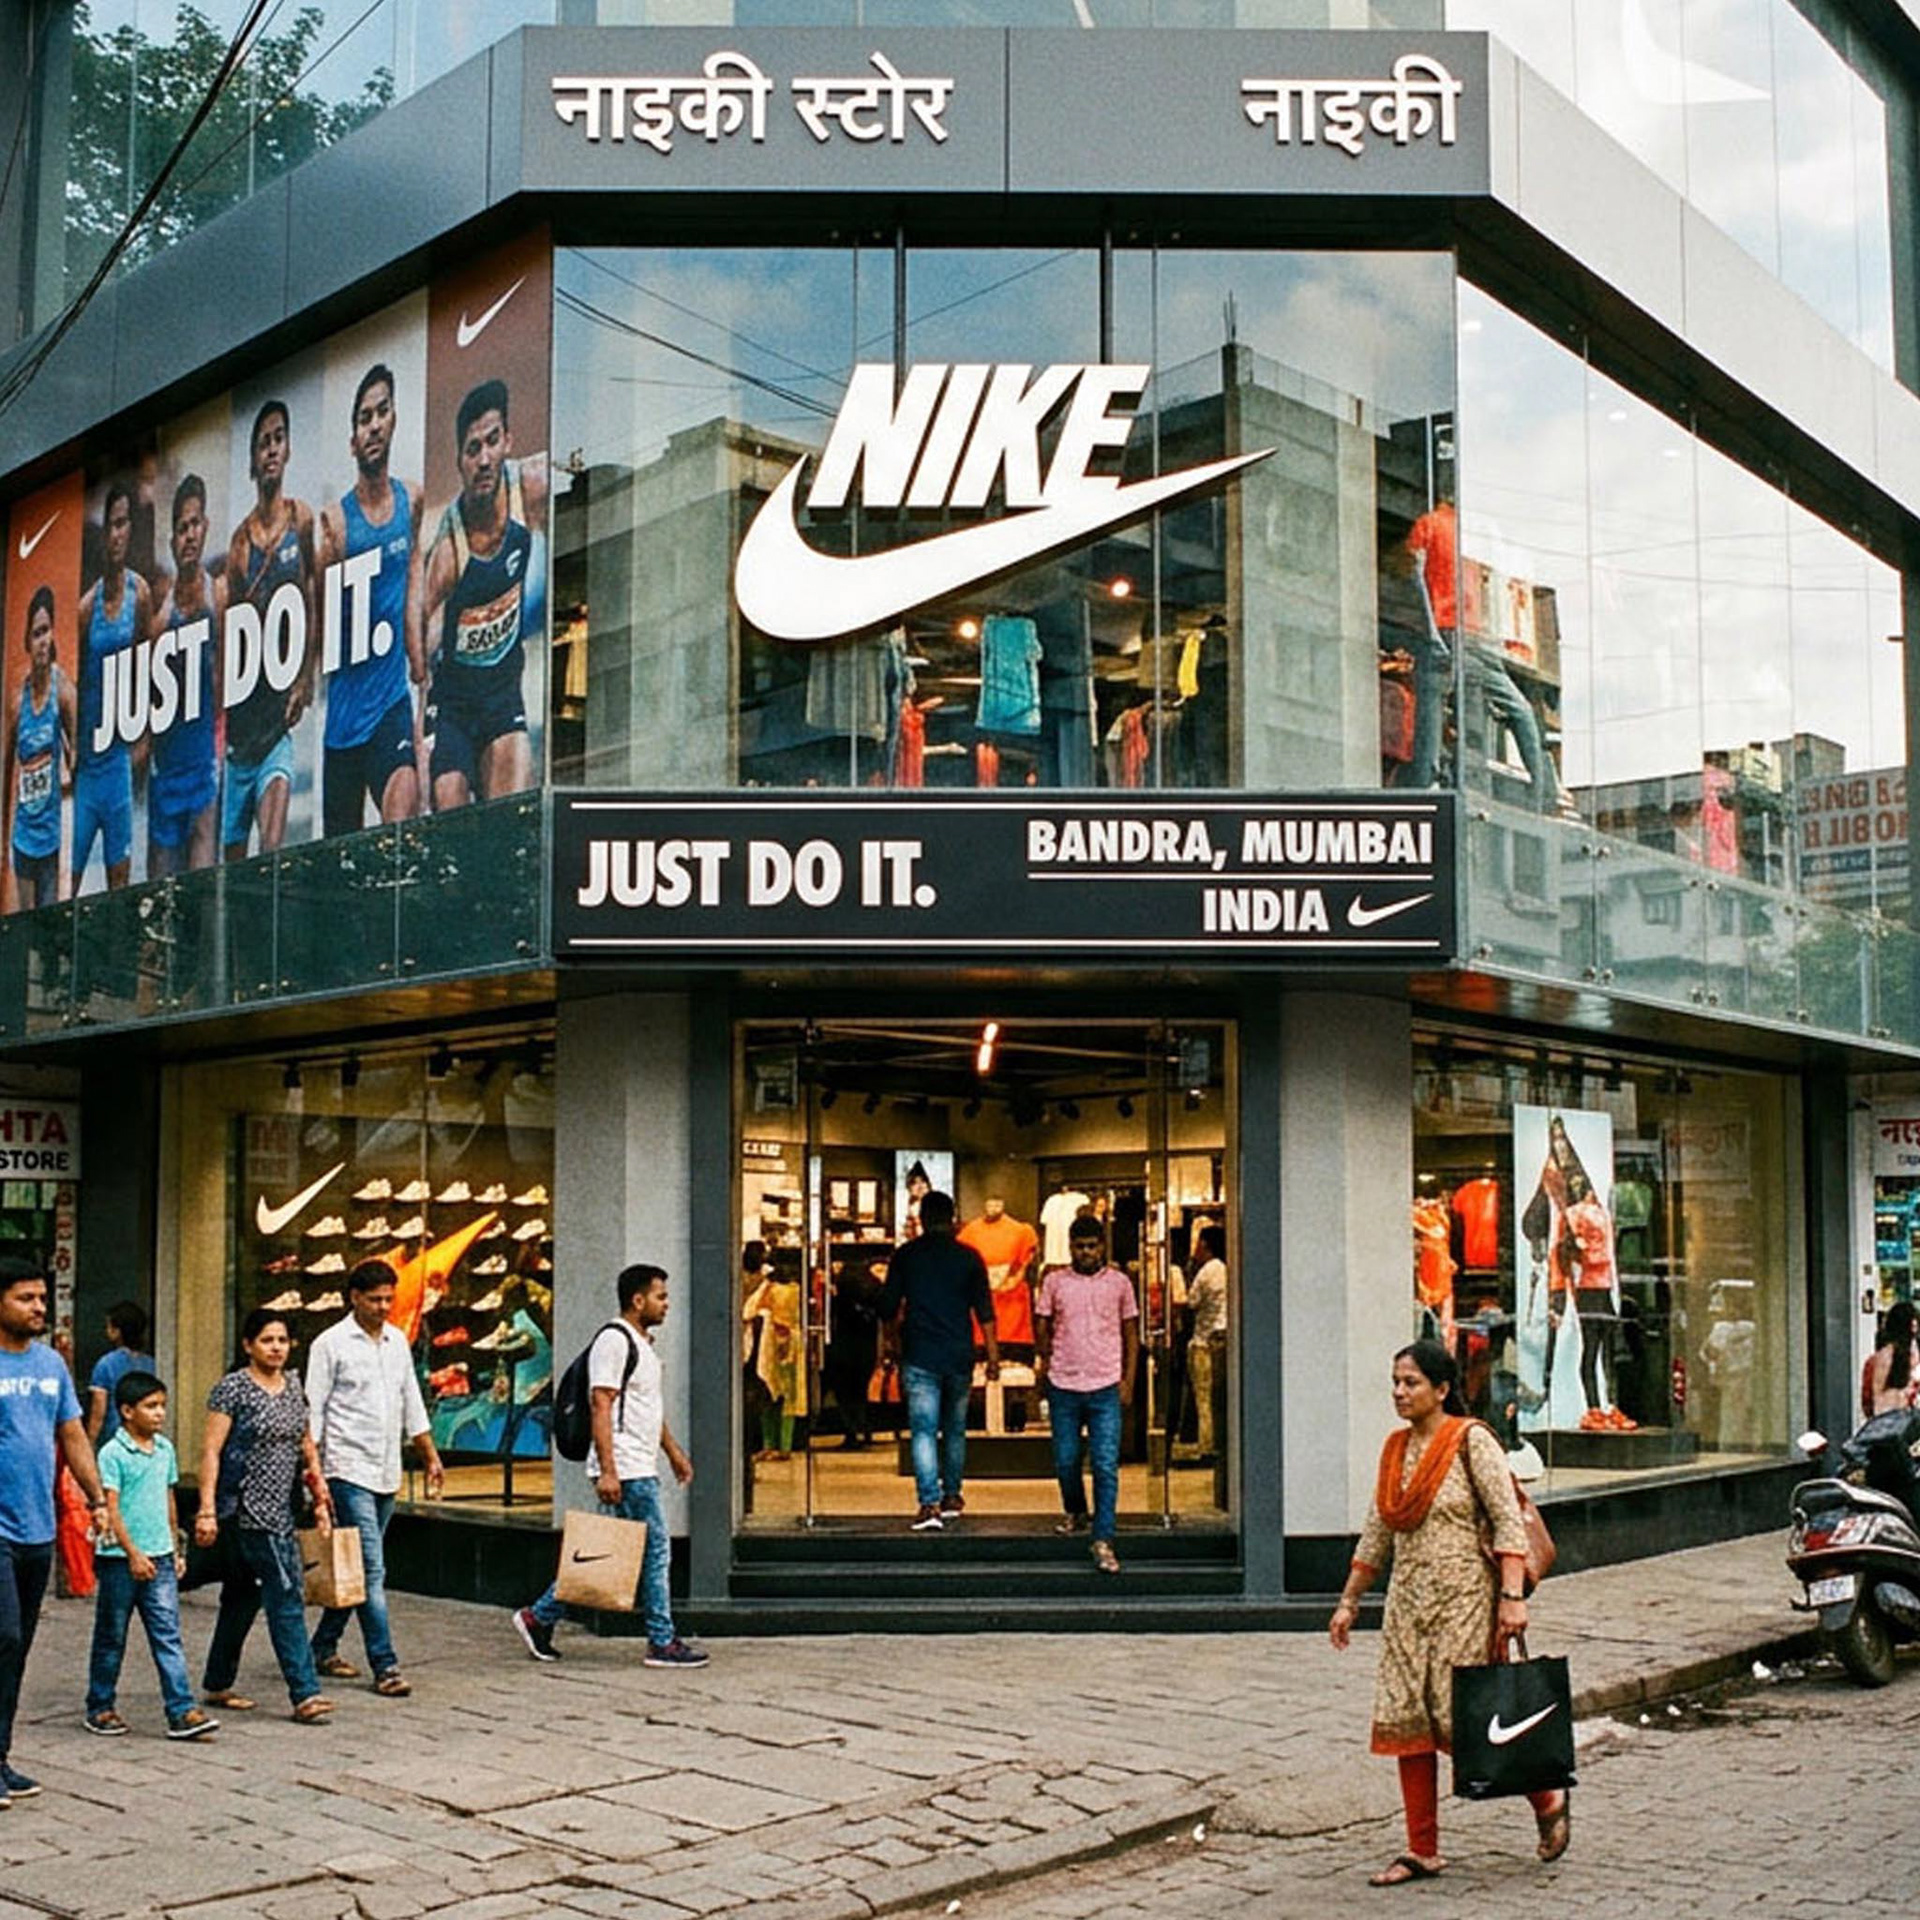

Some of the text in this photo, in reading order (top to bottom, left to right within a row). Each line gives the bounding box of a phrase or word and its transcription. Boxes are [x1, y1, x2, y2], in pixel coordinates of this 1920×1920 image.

[552, 52, 954, 152] नाइकी स्टोर
[1241, 54, 1464, 155] नाइकी
[806, 363, 1152, 508] NIKE
[93, 546, 394, 753] JUST DO IT.
[578, 840, 937, 908] JUST DO IT.
[1027, 820, 1433, 871] BANDRA, MUMBAI
[1203, 889, 1330, 932] INDIA
[0, 1149, 71, 1171] STORE
